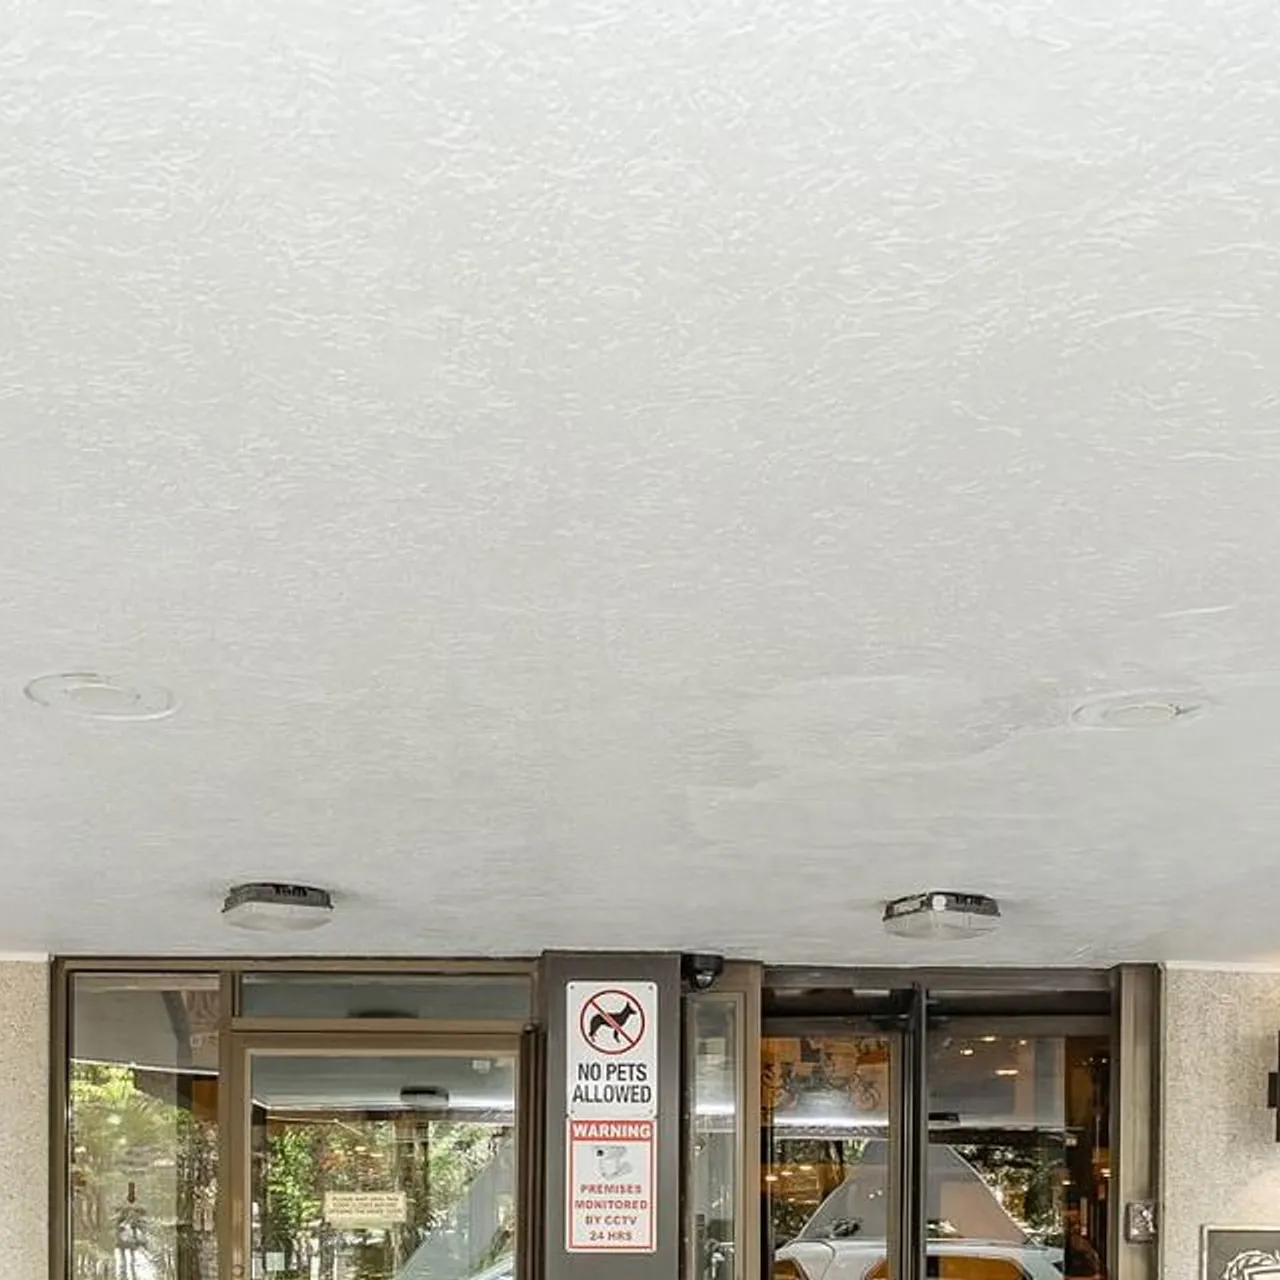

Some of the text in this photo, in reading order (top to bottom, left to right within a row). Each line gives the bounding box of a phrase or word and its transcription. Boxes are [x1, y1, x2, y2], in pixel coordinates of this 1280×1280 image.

[578, 1063, 647, 1082] NO PETS
[572, 1084, 651, 1103] ALLOWED
[572, 1123, 651, 1139] WARNING
[580, 1184, 642, 1194] PREMISES
[575, 1200, 648, 1209] MONITORED
[585, 1215, 638, 1225] BY CCTV
[589, 1231, 632, 1241] 24 HRS
